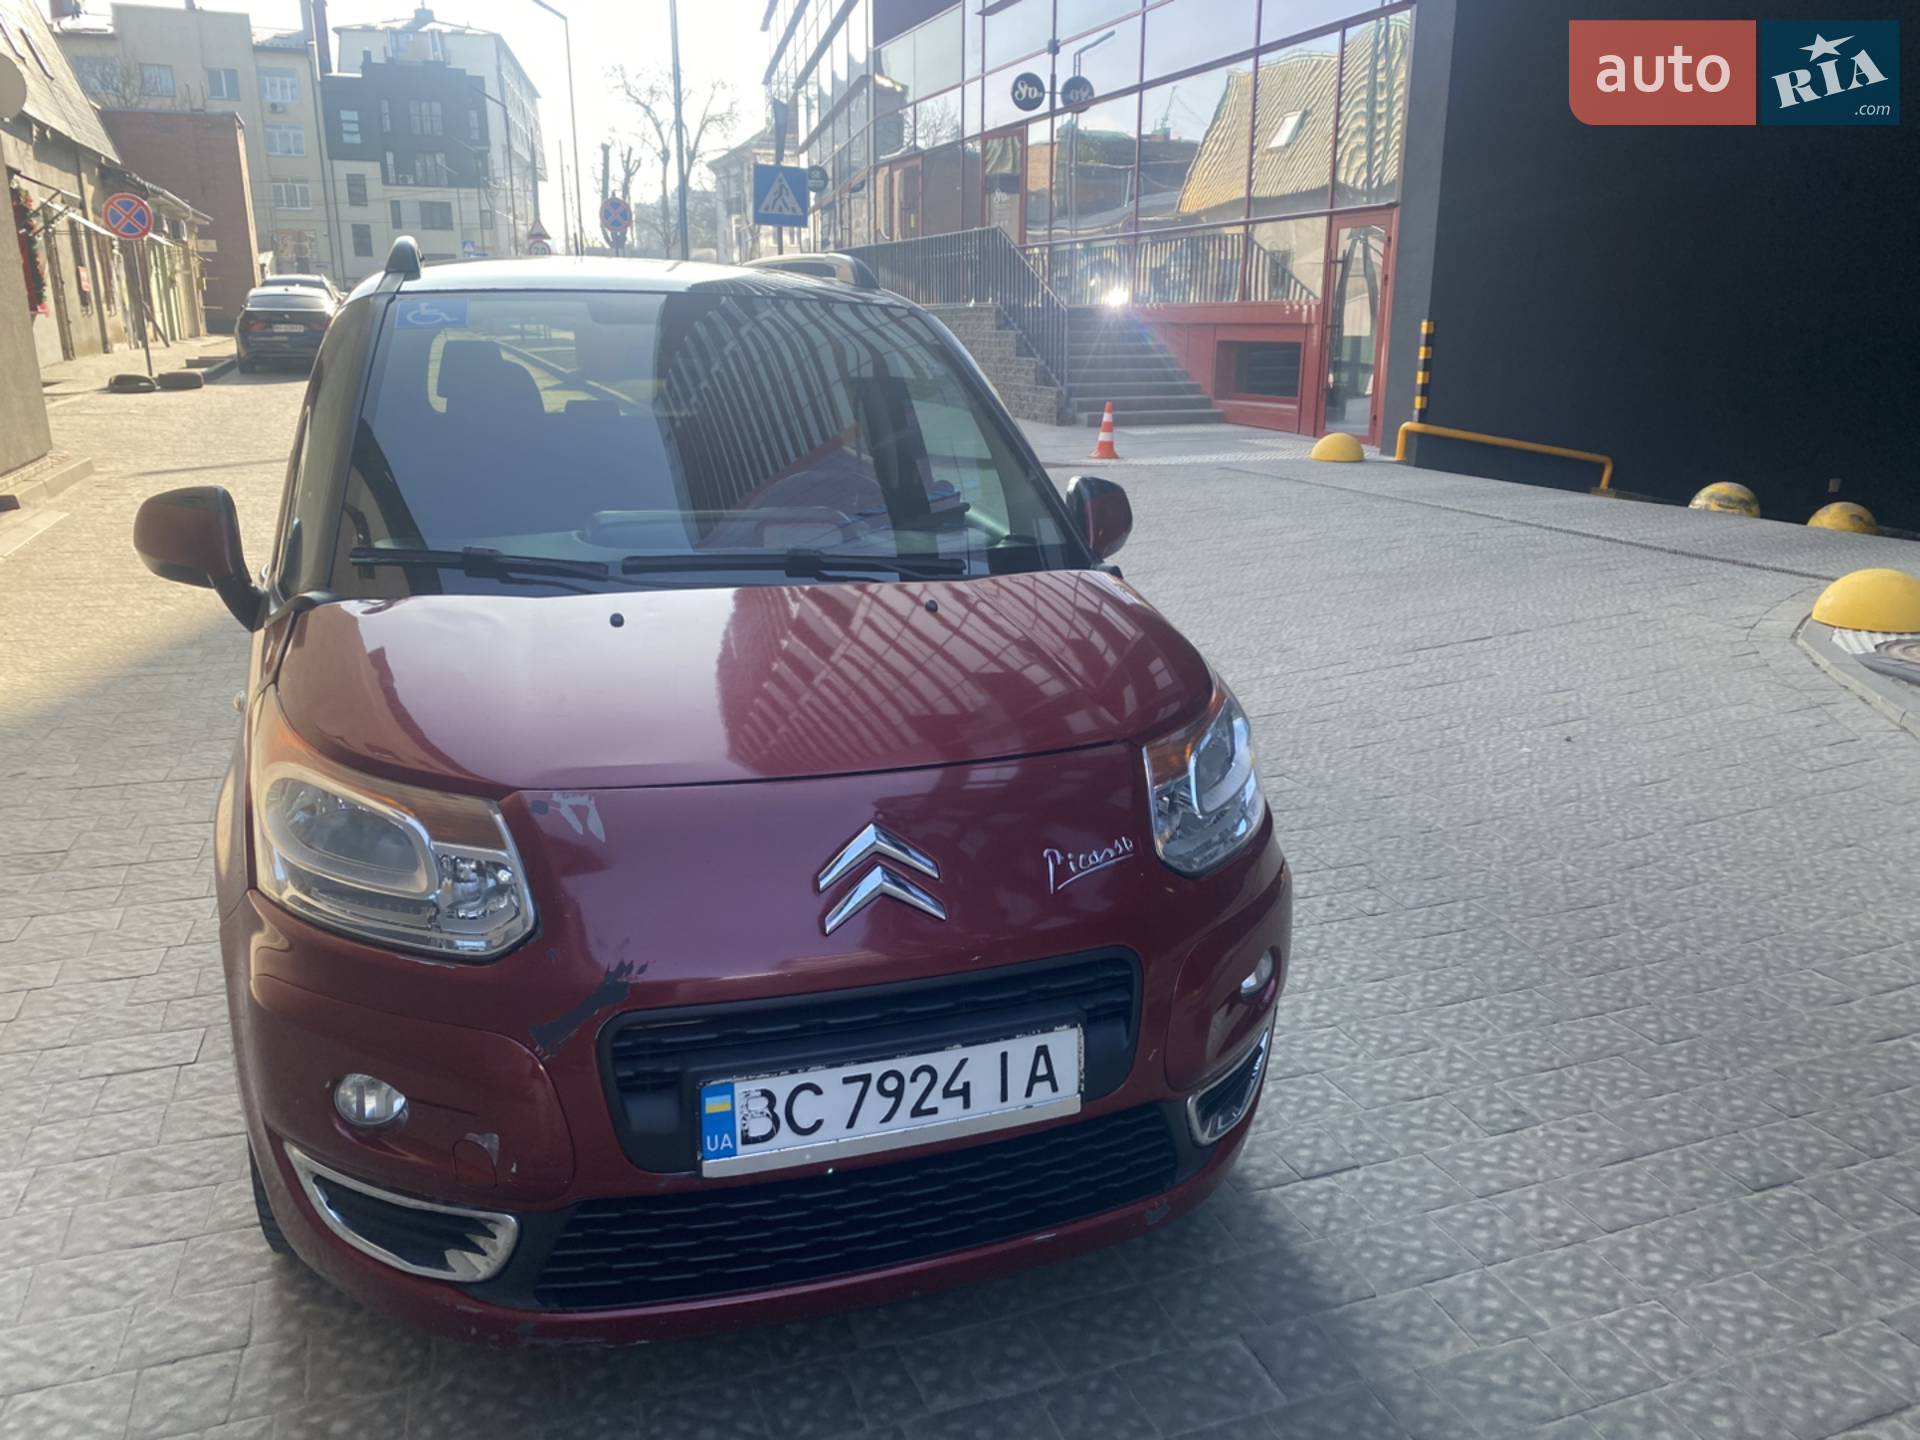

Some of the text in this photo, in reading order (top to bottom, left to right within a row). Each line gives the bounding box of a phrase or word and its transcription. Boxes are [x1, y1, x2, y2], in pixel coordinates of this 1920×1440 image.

[1043, 836, 1133, 894] Picasso
[740, 1044, 1059, 1147] BC 7924 IA
[706, 1133, 733, 1151] UA
